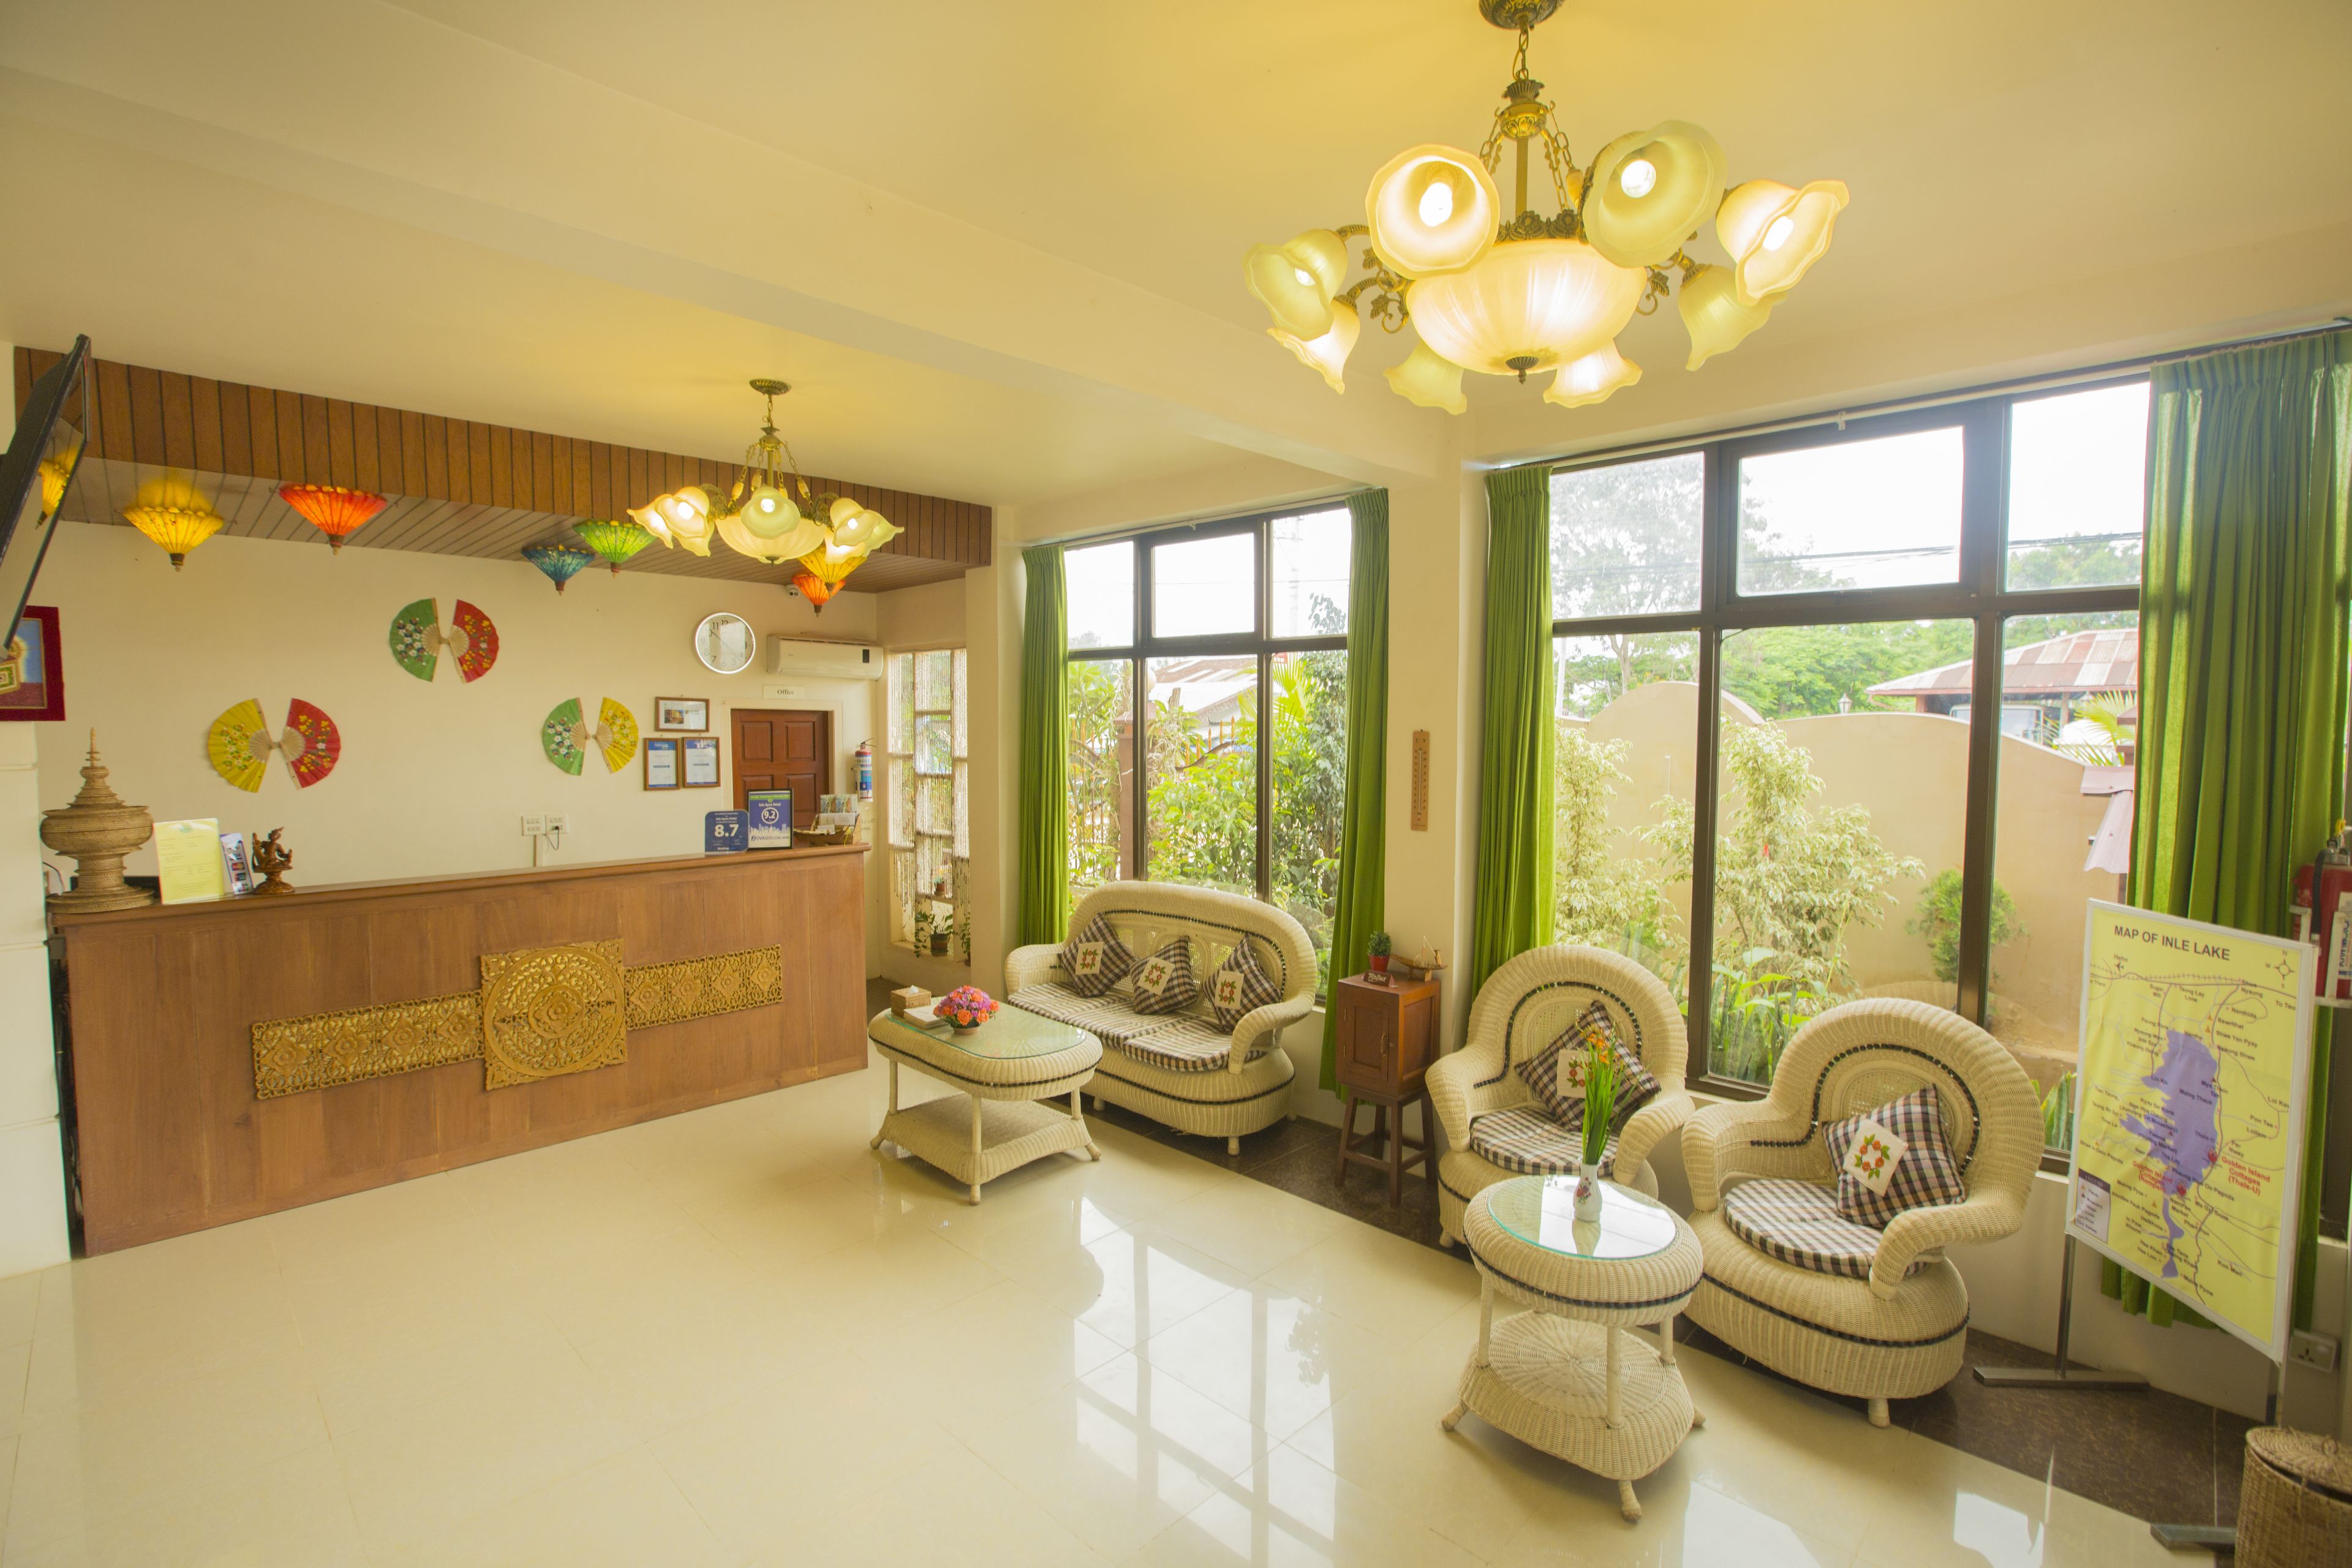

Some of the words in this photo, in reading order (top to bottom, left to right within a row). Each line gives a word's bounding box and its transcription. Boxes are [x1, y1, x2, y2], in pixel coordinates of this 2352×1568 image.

[712, 622, 718, 630] 11
[764, 810, 775, 819] 9.2
[714, 823, 739, 837] 8.7
[2114, 925, 2139, 939] MAP
[2142, 931, 2158, 944] OF
[2162, 935, 2190, 952] INLE
[2194, 942, 2230, 961] LAKE
[2114, 954, 2128, 962] Heho
[2242, 979, 2257, 988] Shwe
[2241, 987, 2264, 998] Nyaung
[2216, 1030, 2231, 1039] Shwe
[2239, 1052, 2255, 1061] Shwe
[2133, 1161, 2154, 1175] Golden
[2154, 1170, 2173, 1184] Island
[2222, 1156, 2247, 1172] Golden
[2248, 1167, 2271, 1183] Island
[2229, 1168, 2261, 1186] Cottages
[2228, 1175, 2260, 1196] (Thale-U)
[2214, 1187, 2234, 1201] Pagoda
